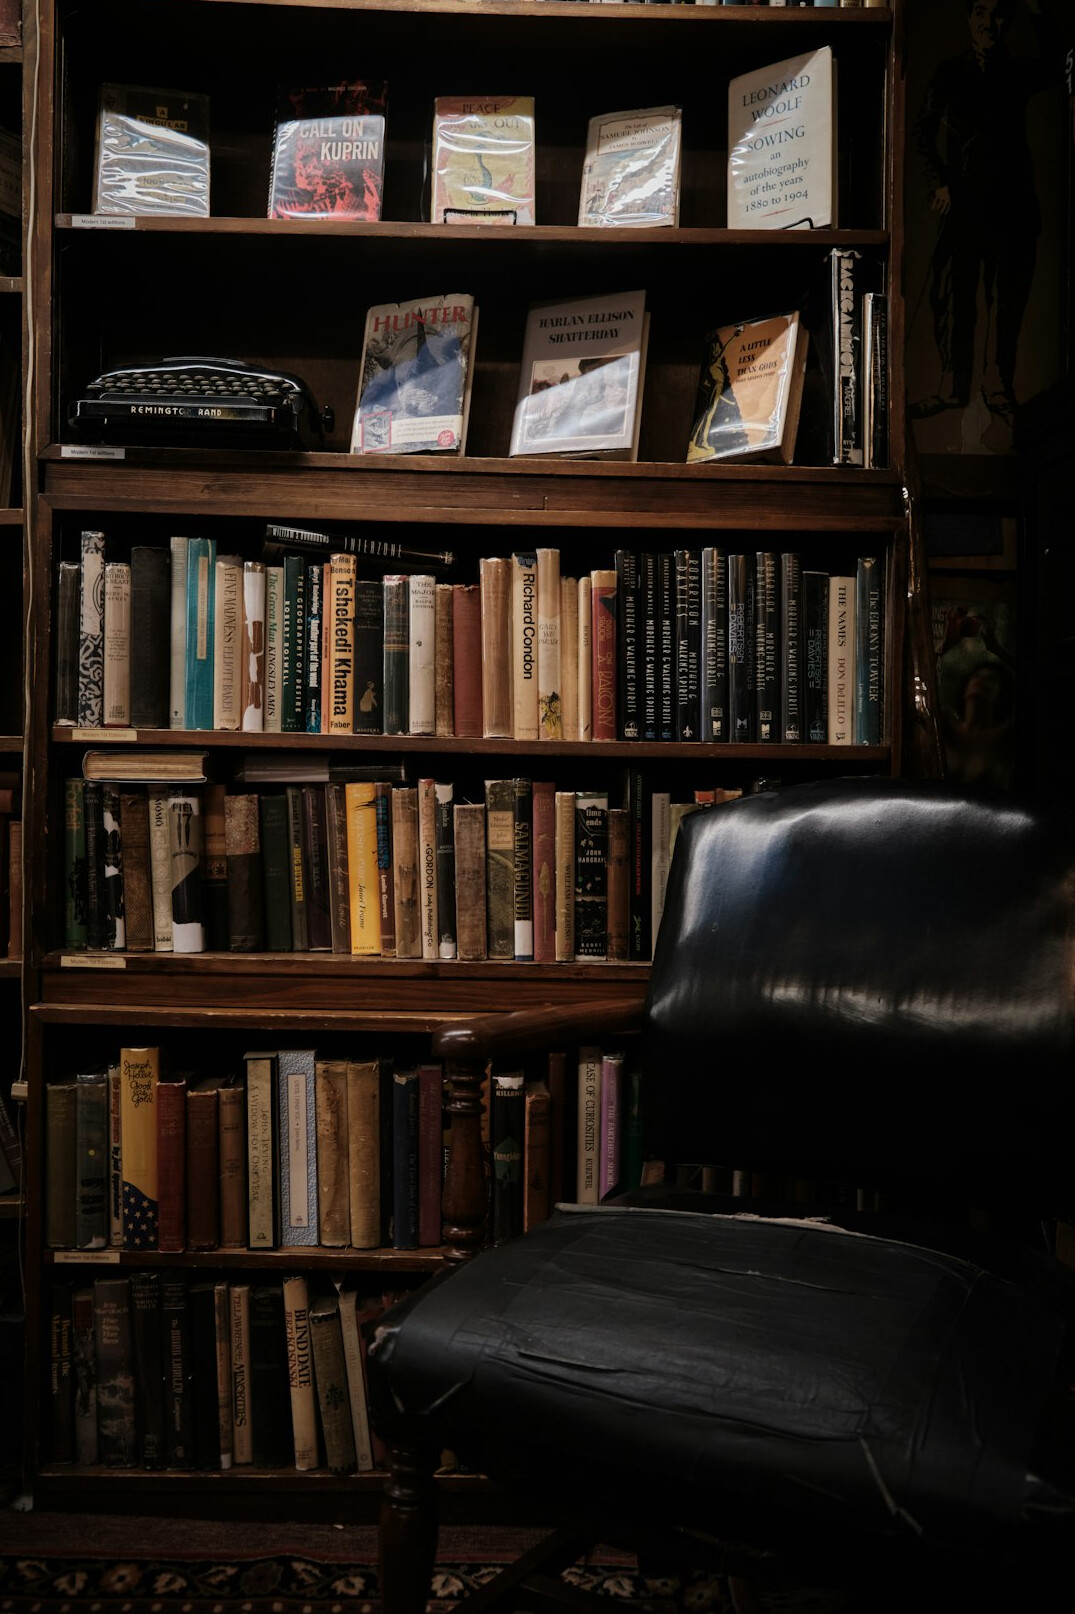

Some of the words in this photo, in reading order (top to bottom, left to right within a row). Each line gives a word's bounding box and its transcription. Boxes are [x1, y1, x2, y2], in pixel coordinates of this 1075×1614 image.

[743, 75, 810, 107] LEONARD
[463, 104, 501, 113] PEACE
[751, 96, 802, 122] WOOLF
[300, 122, 336, 138] CALL
[342, 119, 364, 137] ON
[494, 119, 519, 129] OUT
[600, 131, 631, 141] SAMUEL
[633, 126, 670, 137] JOHNSON
[747, 126, 805, 152] SOWING
[321, 141, 379, 160] KUPRIN
[770, 152, 781, 160] an
[744, 160, 809, 185] autobiography
[750, 185, 760, 198] of
[762, 183, 777, 195] the
[780, 177, 803, 194] years
[745, 198, 768, 212] 1880
[771, 196, 782, 206] to
[785, 190, 808, 203] 1904
[374, 306, 469, 333] HUNTER
[540, 315, 585, 329] HARLAN
[588, 310, 635, 325] ELLISON
[840, 258, 855, 378] BACKGAMMON
[549, 328, 618, 344] SHATTERDAY
[740, 345, 746, 353] A
[748, 338, 772, 351] LITTLE
[737, 366, 757, 376] THAN
[759, 360, 778, 371] GODS
[739, 354, 756, 364] LESS
[198, 408, 221, 417] RAND
[224, 573, 237, 595] FINE
[269, 572, 278, 589] The
[296, 576, 304, 592] THE
[676, 566, 687, 617] DAVIES
[689, 559, 699, 626] ROBERTSON
[707, 561, 716, 603] DAVIES
[717, 556, 725, 608] ROBERTSON
[756, 566, 764, 607] DAVIES
[766, 560, 775, 612] ROBERTSON
[269, 591, 278, 619] Green
[523, 573, 535, 624] Richard
[838, 586, 846, 606] THE
[869, 590, 879, 610] The
[223, 598, 236, 642] MADNESS
[296, 598, 304, 657] GEOGRAPHY
[335, 578, 353, 653] Tshekedi
[626, 596, 636, 633] MURTHER
[788, 600, 797, 636] MURTHER
[838, 611, 846, 647] NAMES
[268, 621, 277, 642] Man
[646, 620, 655, 653] MURTHER
[662, 620, 671, 654] MURTHER
[707, 619, 716, 652] WALKING
[756, 623, 765, 656] WALKING
[869, 611, 879, 652] EBONY
[222, 646, 234, 683] ELLIOTT
[523, 627, 535, 680] Condon
[626, 645, 636, 679] WALKING
[679, 640, 687, 672] WALKING
[717, 629, 725, 670] MURTHER
[766, 632, 774, 673] MURTHER
[788, 648, 797, 681] WALKING
[814, 630, 822, 688] ROBERTSON
[267, 646, 276, 689] KINGSLEY
[295, 662, 303, 674] OF
[646, 663, 655, 693] WALKING
[662, 664, 671, 694] WALKING
[689, 651, 697, 689] MURTHER
[707, 656, 716, 687] SPIRITS
[756, 659, 765, 691] SPIRITS
[837, 658, 846, 680] DON
[869, 655, 879, 701] TOWER
[222, 684, 233, 712] BAKER
[295, 679, 303, 712] DESIRE
[334, 657, 351, 716] Khama
[598, 671, 614, 727] BALCONY
[626, 682, 636, 713] SPIRITS
[679, 675, 687, 705] SPIRITS
[788, 684, 797, 715] SPIRITS
[267, 690, 276, 716] AMIS
[646, 696, 655, 723] SPIRITS
[662, 696, 671, 724] SPIRITS
[837, 683, 845, 724] DeLILLO
[331, 720, 351, 728] Faber
[423, 798, 433, 843] BOXER
[586, 809, 602, 817] time
[293, 848, 302, 864] HOG
[425, 847, 434, 889] GORDON
[294, 866, 304, 902] BUTCHER
[358, 884, 366, 903] Janet
[562, 864, 572, 899] WILLIAM
[381, 895, 389, 919] Garrett
[425, 893, 433, 907] Judy
[358, 905, 366, 930] Frame
[425, 908, 433, 938] Publishing
[427, 938, 433, 947] Co
[123, 1060, 152, 1075] Joseph
[128, 1069, 154, 1080] Heller
[585, 1061, 595, 1083] CASE
[129, 1080, 151, 1089] Good
[585, 1085, 595, 1097] OF
[131, 1094, 153, 1109] Gold
[251, 1094, 260, 1129] WIDOW
[607, 1105, 615, 1118] THE
[261, 1110, 269, 1133] JOHN
[585, 1100, 595, 1152] CURIOSITIES
[111, 1146, 120, 1155] by
[251, 1134, 260, 1151] FOR
[607, 1122, 615, 1159] FARTHEST
[112, 1156, 120, 1170] joel
[251, 1156, 260, 1175] ONE
[261, 1140, 269, 1173] IRVING
[585, 1158, 593, 1190] KURZWEIL
[607, 1161, 615, 1186] SHORE
[251, 1181, 260, 1201] YEAR
[286, 1311, 295, 1336] JERZY
[294, 1308, 309, 1350] BLIND
[287, 1336, 298, 1389] KOSINSKI
[296, 1354, 311, 1388] DATE
[234, 1362, 247, 1427] MINORITIES
